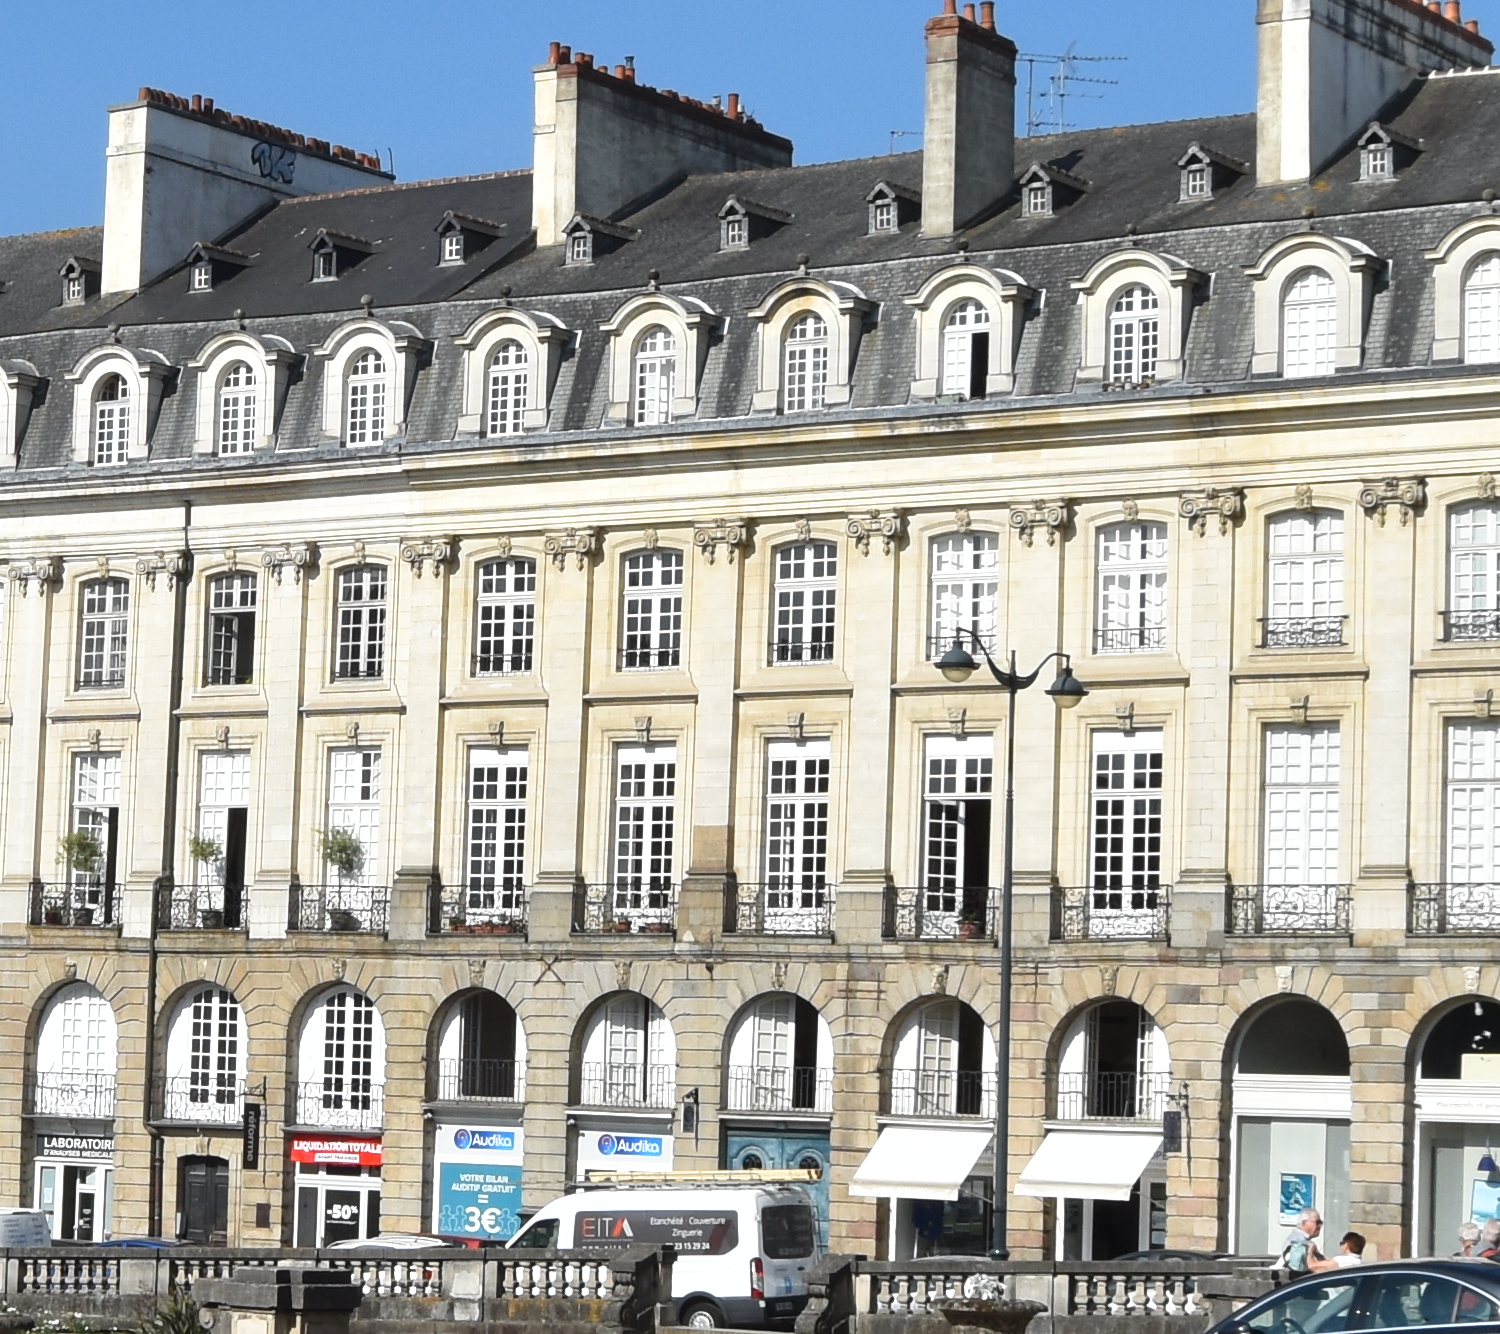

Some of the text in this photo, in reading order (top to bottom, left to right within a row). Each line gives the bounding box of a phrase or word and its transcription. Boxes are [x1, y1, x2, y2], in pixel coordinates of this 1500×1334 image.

[246, 1110, 258, 1162] réforme
[472, 1133, 512, 1147] Audika
[293, 1140, 349, 1153] LIQUIDATION
[617, 1138, 660, 1153] Audika
[459, 1173, 509, 1184] VOTRE BILAN
[451, 1182, 480, 1192] AUDITIF
[326, 1204, 359, 1220] -50%
[464, 1206, 502, 1234] 3€
[688, 1216, 726, 1226] Couverture
[671, 1228, 704, 1239] Zinguerie
